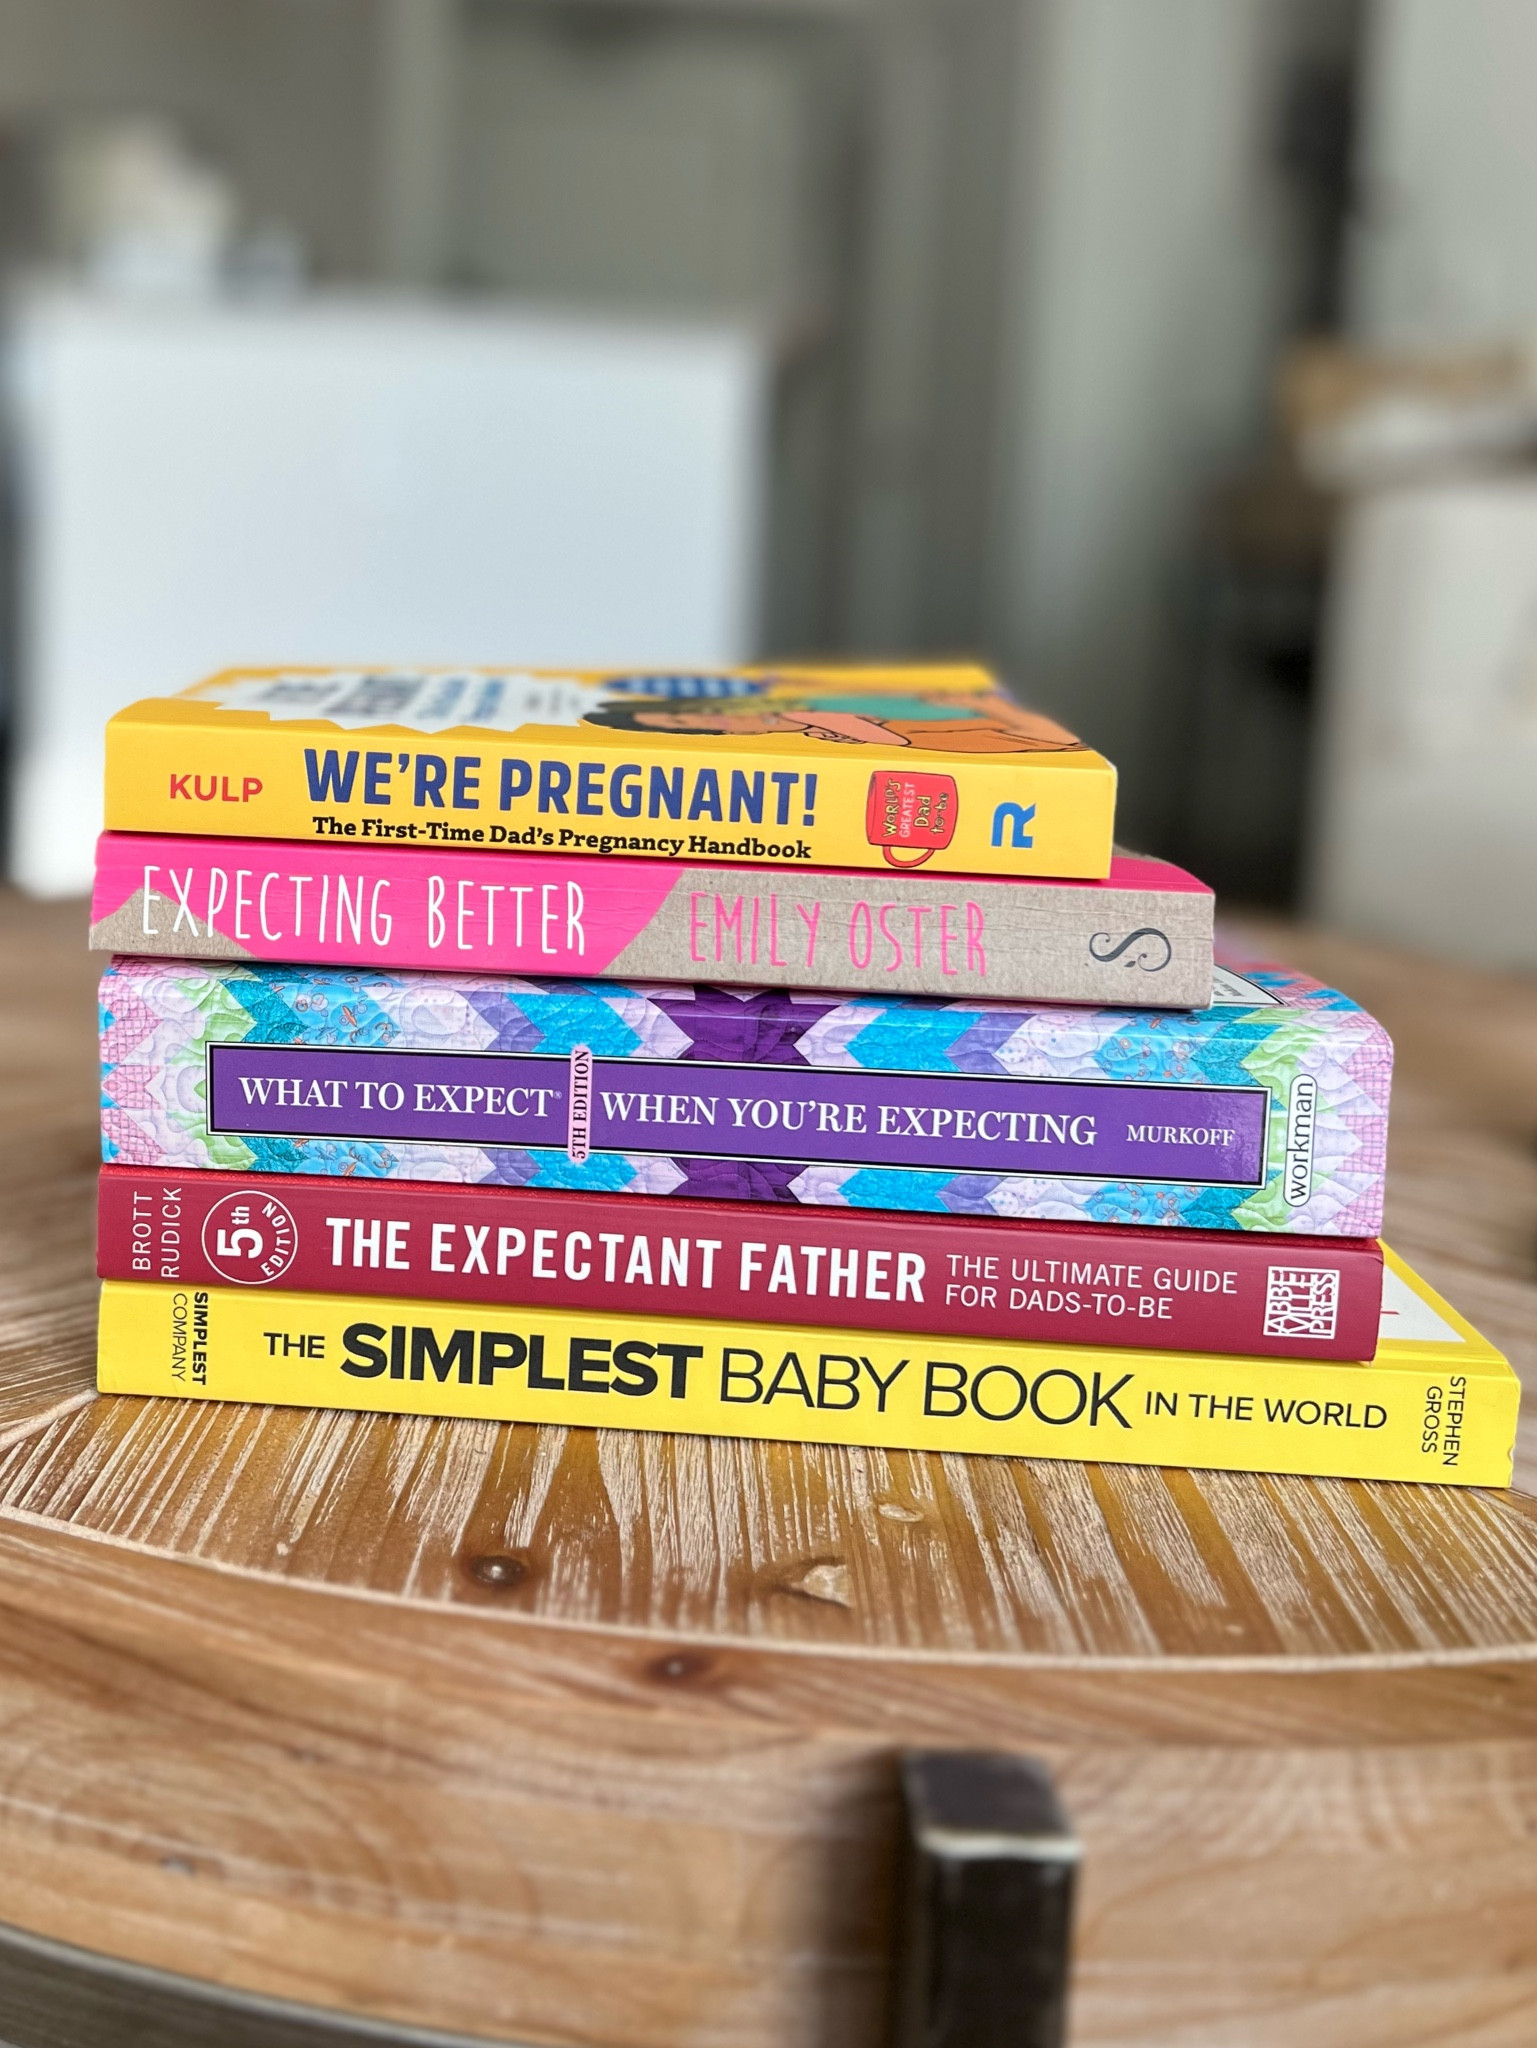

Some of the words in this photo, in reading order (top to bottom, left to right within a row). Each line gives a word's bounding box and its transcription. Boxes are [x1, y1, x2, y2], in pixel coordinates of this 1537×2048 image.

[169, 773, 263, 803] KULP
[304, 748, 481, 811] WE'RE
[499, 758, 818, 827] PREGNANT!
[899, 782, 915, 838] GREATEST
[914, 796, 931, 827] Dad
[313, 816, 356, 836] The
[361, 818, 484, 843] First-Time
[490, 825, 554, 847] Dad's
[558, 828, 686, 857] Pregnancy
[688, 836, 812, 860] Handbook
[142, 865, 391, 947] EXPECTING
[427, 875, 585, 956] BETTER
[690, 892, 821, 968] EMILY
[849, 900, 987, 977] OSTER
[238, 1076, 348, 1109] WHAT
[355, 1081, 405, 1110] TO
[573, 1050, 589, 1122] EDITION
[600, 1091, 717, 1126] WHEN
[727, 1098, 867, 1134] YOU'RE
[876, 1104, 1097, 1147] EXPECTING
[572, 1127, 586, 1159] 5TH
[1126, 1124, 1236, 1148] MURKOFF
[1287, 1081, 1314, 1201] workman
[132, 1191, 152, 1270] BROTT
[161, 1187, 182, 1278] RUDICK
[217, 1206, 264, 1259] 5th
[260, 1201, 291, 1277] EDITION
[326, 1217, 411, 1271] THE
[430, 1223, 722, 1290] EXPECTANT
[739, 1242, 926, 1304] FATHER
[945, 1254, 1000, 1281] THE
[1011, 1259, 1142, 1288] ULTIMATE
[1153, 1266, 1238, 1295] GUIDE
[945, 1284, 997, 1310] FOR
[1009, 1290, 1173, 1320] DADS-TO-BE
[171, 1293, 188, 1382] COMPANY
[192, 1291, 209, 1385] SIMPLEST
[263, 1332, 325, 1359] THE
[340, 1322, 703, 1399] SIMPLEST
[720, 1347, 911, 1413] BABY
[923, 1360, 1135, 1430] BOOK
[1145, 1391, 1178, 1417] IN
[1188, 1393, 1253, 1422] THE
[1264, 1398, 1388, 1430] WORLD
[1421, 1386, 1443, 1453] GROSS
[1443, 1376, 1467, 1467] STEPHEN
